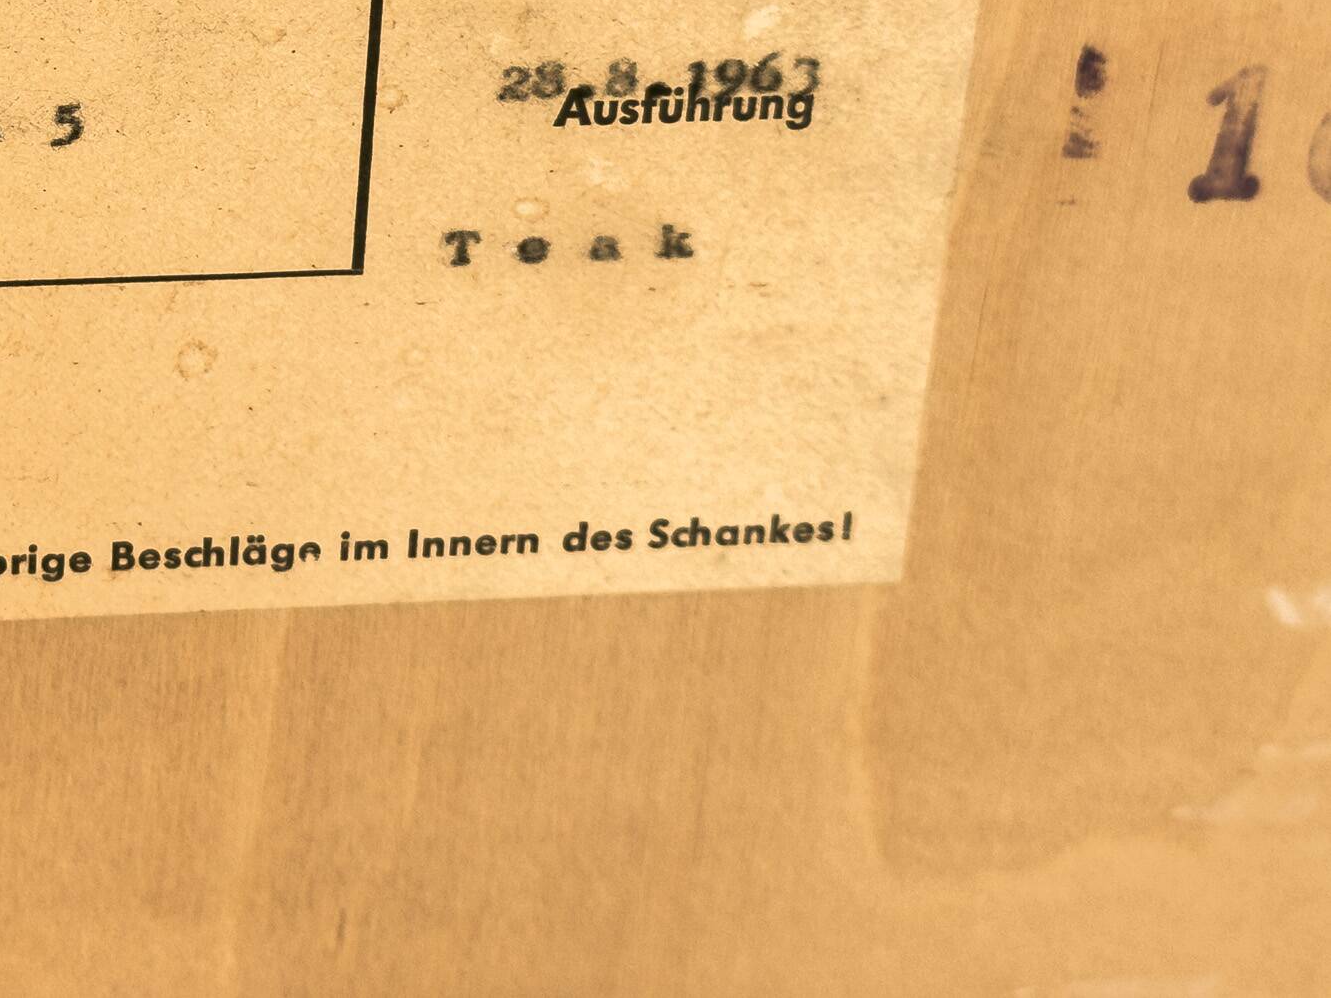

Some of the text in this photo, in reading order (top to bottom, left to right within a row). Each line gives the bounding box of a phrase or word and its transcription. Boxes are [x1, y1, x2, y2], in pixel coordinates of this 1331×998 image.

[48, 100, 86, 148] 5
[552, 84, 816, 132] Ausführung
[110, 534, 322, 574] Beschläge
[338, 530, 390, 564] im
[406, 528, 542, 560] Innern
[560, 522, 634, 554] des
[646, 510, 856, 550] Schankes!
